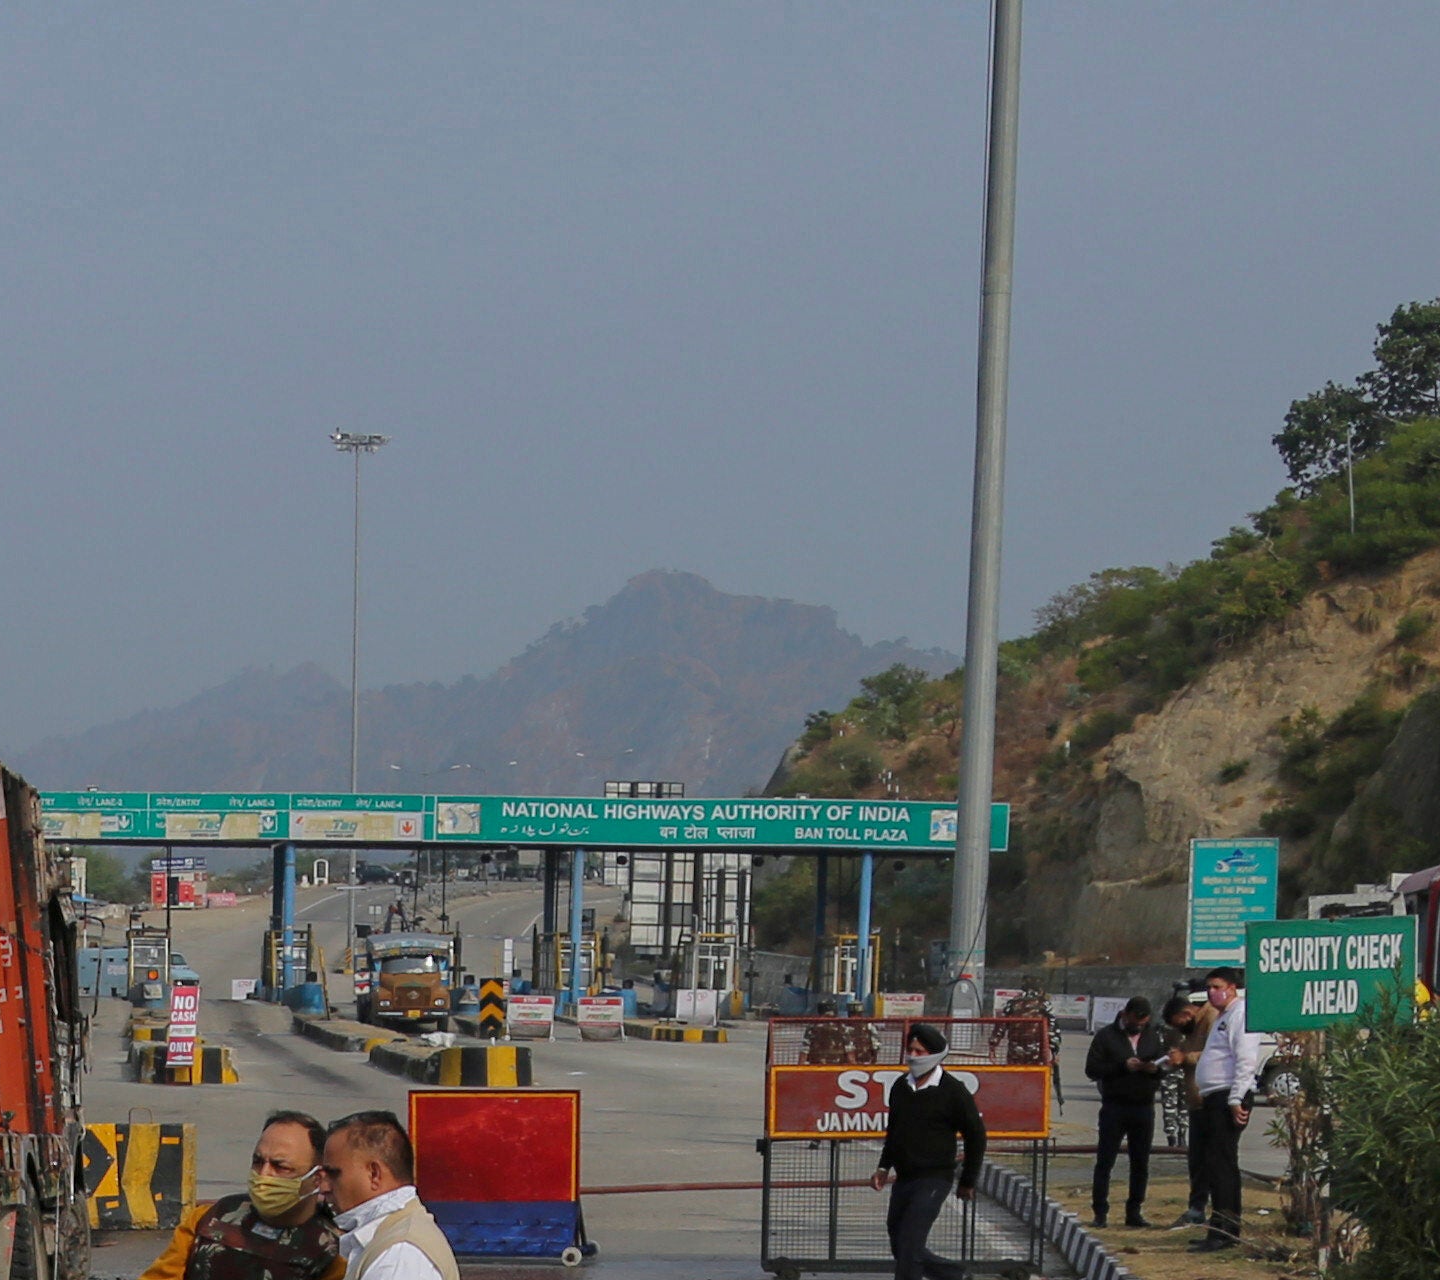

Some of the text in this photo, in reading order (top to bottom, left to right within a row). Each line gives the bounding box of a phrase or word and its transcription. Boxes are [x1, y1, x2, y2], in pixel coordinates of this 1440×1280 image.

[502, 802, 910, 822] NATIONAL HIGHWAYS AUTHORITY OF INDIA
[684, 823, 709, 839] टोल
[794, 827, 908, 841] BAN TOLL PLAZA
[1259, 934, 1403, 973] SECURITY CHECK
[174, 996, 195, 1010] NO
[1301, 980, 1359, 1016] AHEAD
[171, 1010, 197, 1022] CASH
[170, 1041, 193, 1053] ONLY
